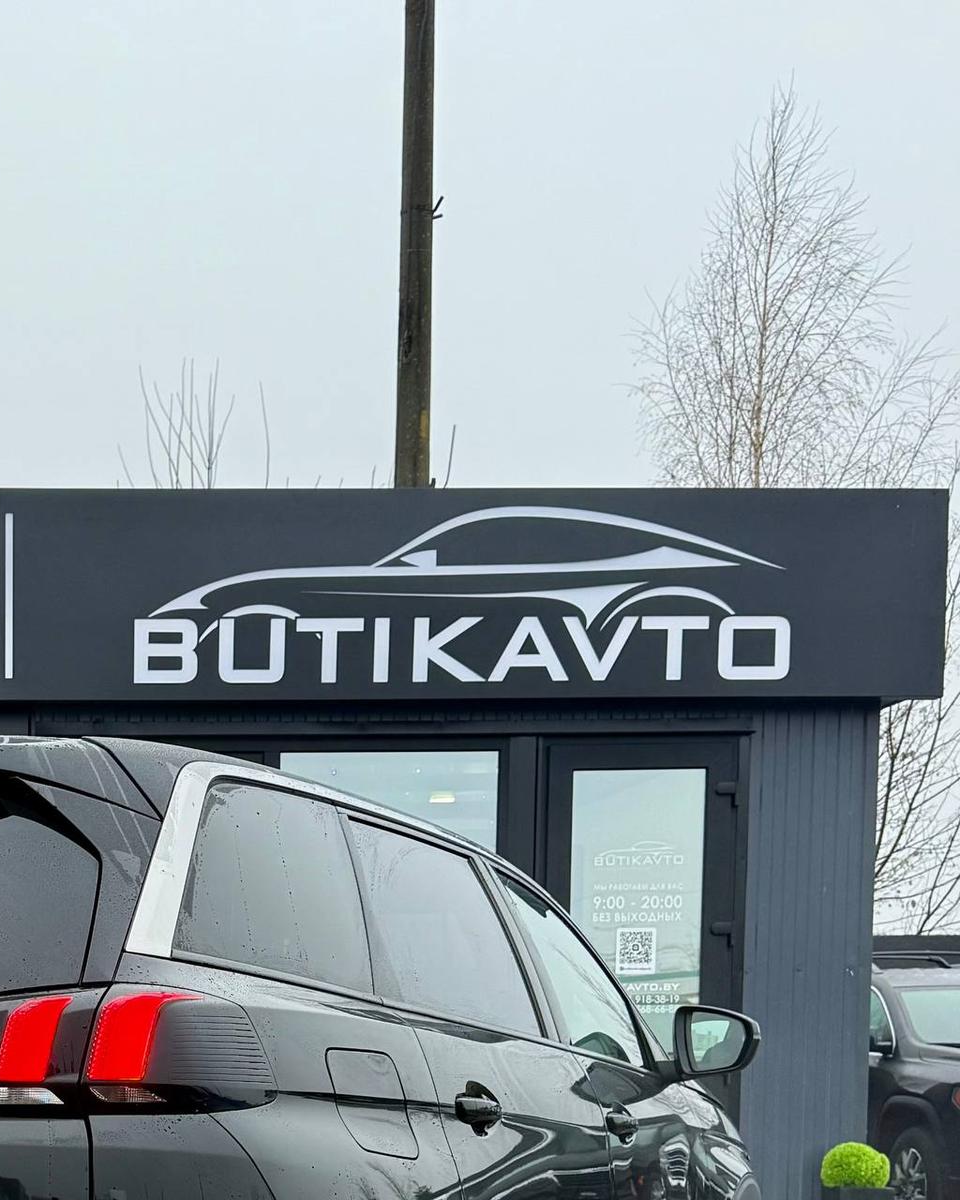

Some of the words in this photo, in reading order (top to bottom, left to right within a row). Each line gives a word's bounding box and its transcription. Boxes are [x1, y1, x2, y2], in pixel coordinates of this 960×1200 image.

[133, 616, 791, 684] BUTIKAVTO
[594, 855, 683, 866] BUTIKAVTO
[593, 896, 625, 909] 9:00
[641, 896, 682, 908] 20:00
[592, 912, 611, 922] БЕЗ
[614, 912, 681, 922] ВЫХОДНЫХ
[635, 994, 680, 1004] 918-38-19
